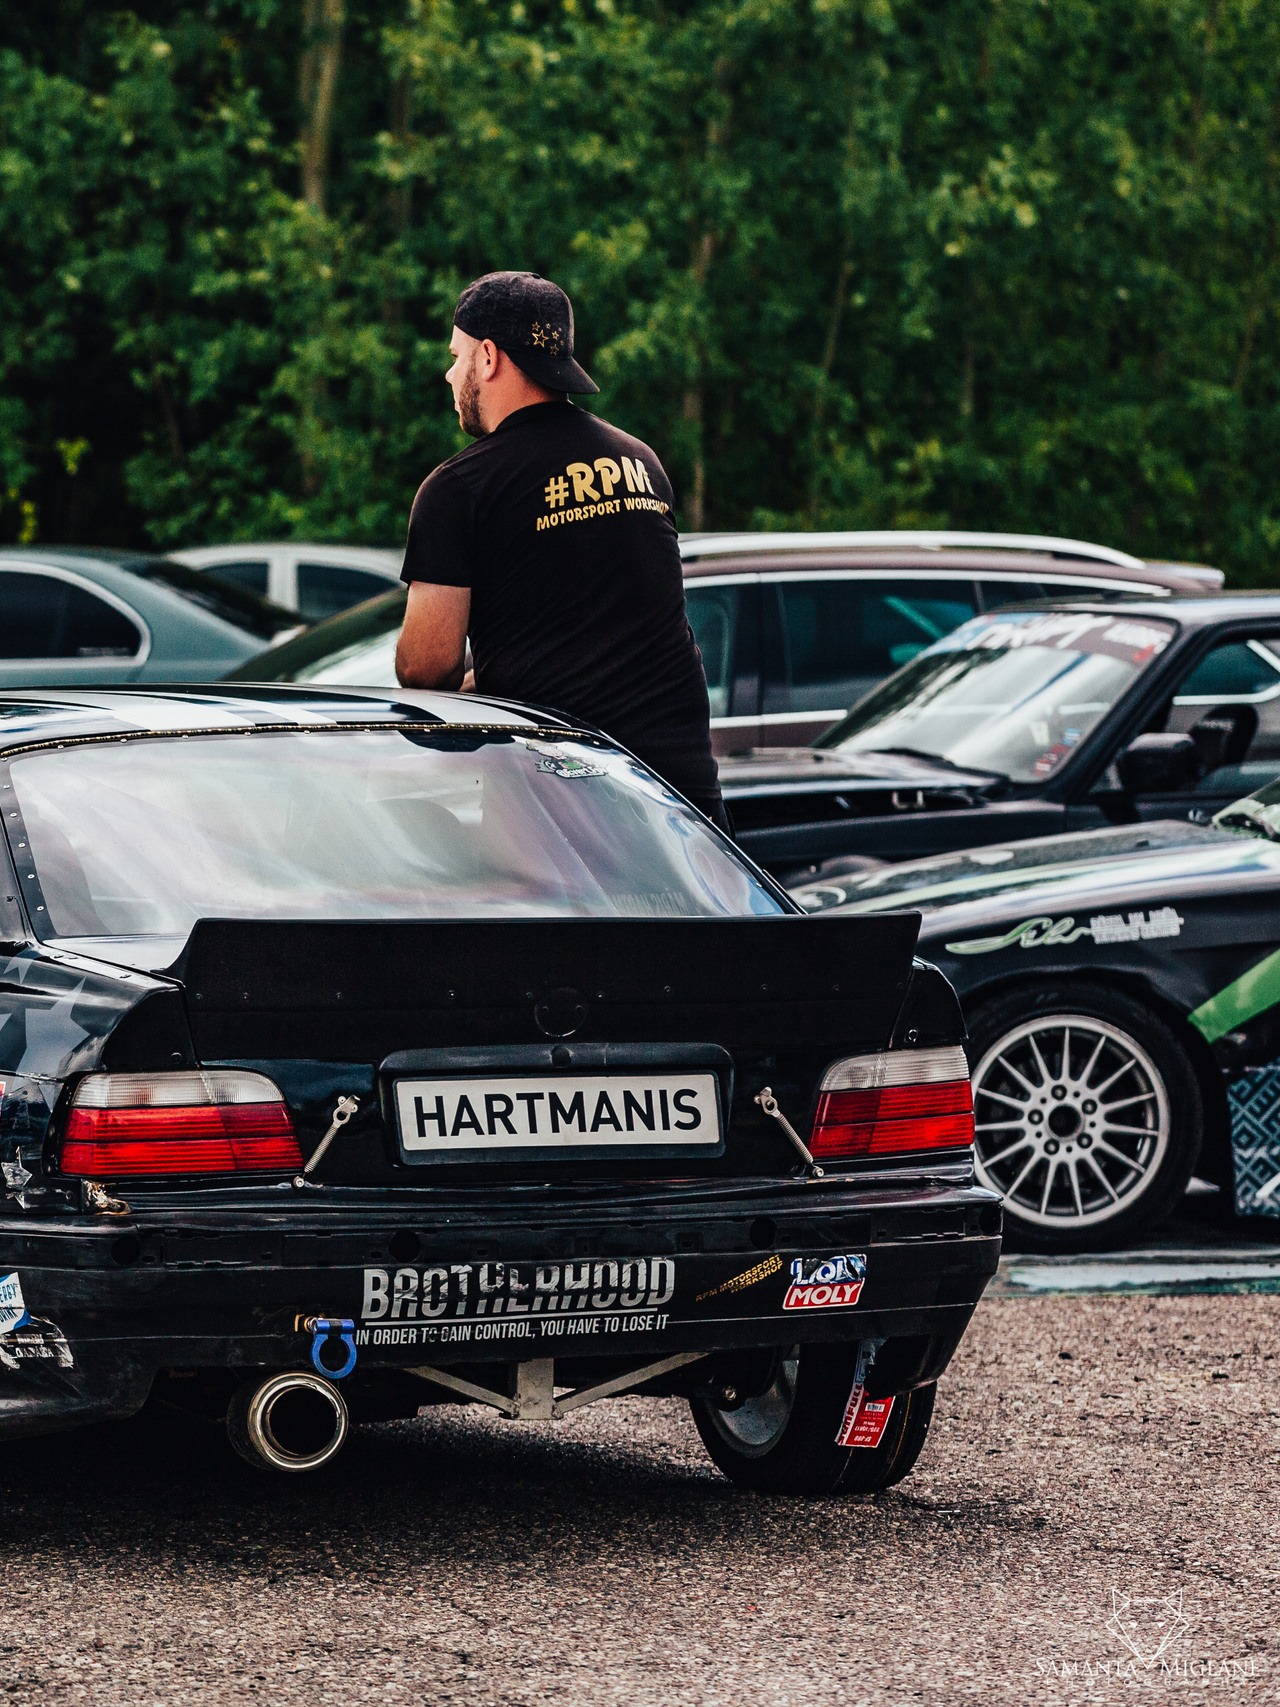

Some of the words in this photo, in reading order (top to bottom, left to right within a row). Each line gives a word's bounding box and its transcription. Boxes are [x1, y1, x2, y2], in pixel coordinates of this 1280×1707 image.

[544, 456, 654, 509] #RPM
[536, 499, 621, 532] MOTORSPORT
[413, 1088, 702, 1138] HARTMANIS
[788, 1283, 861, 1306] MOLY
[355, 1329, 369, 1346] IN
[373, 1327, 417, 1345] ORDER
[474, 1322, 536, 1340] CONTROL,
[540, 1320, 565, 1337] YOU
[567, 1318, 599, 1335] HAVE
[603, 1317, 620, 1333] TO
[622, 1316, 654, 1332] LOSE
[656, 1314, 670, 1330] IT
